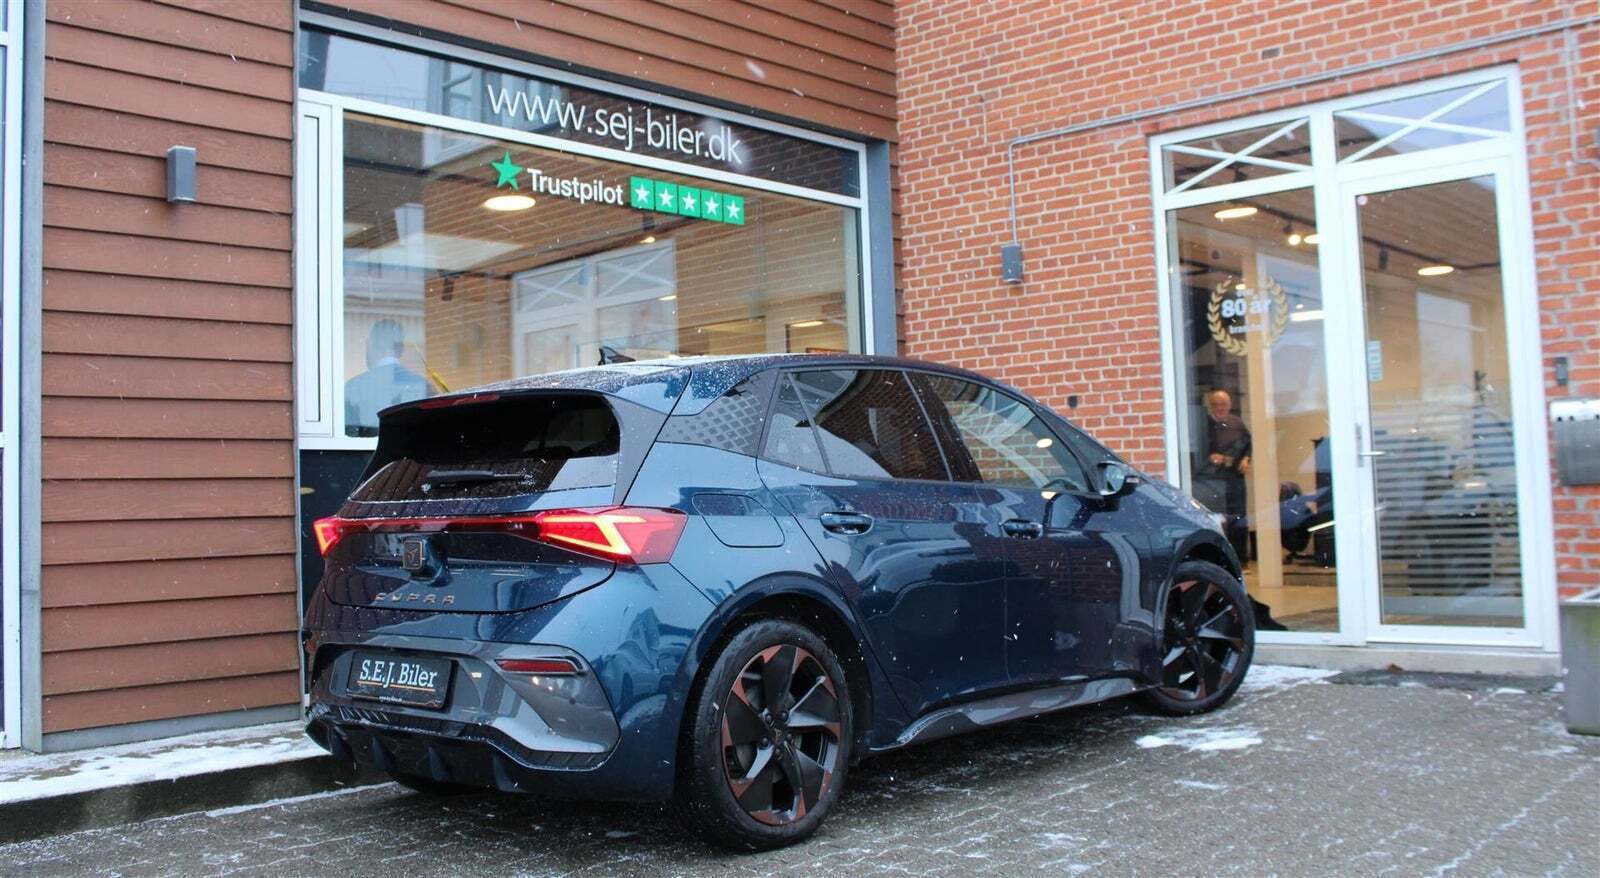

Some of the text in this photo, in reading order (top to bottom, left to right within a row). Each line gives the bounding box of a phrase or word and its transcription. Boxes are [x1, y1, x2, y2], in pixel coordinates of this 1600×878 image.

[487, 84, 743, 165] www.sej-biler.dk
[527, 167, 624, 206] Trustpilot
[1221, 298, 1248, 318] 80
[359, 659, 438, 688] S.E.J. Biler
